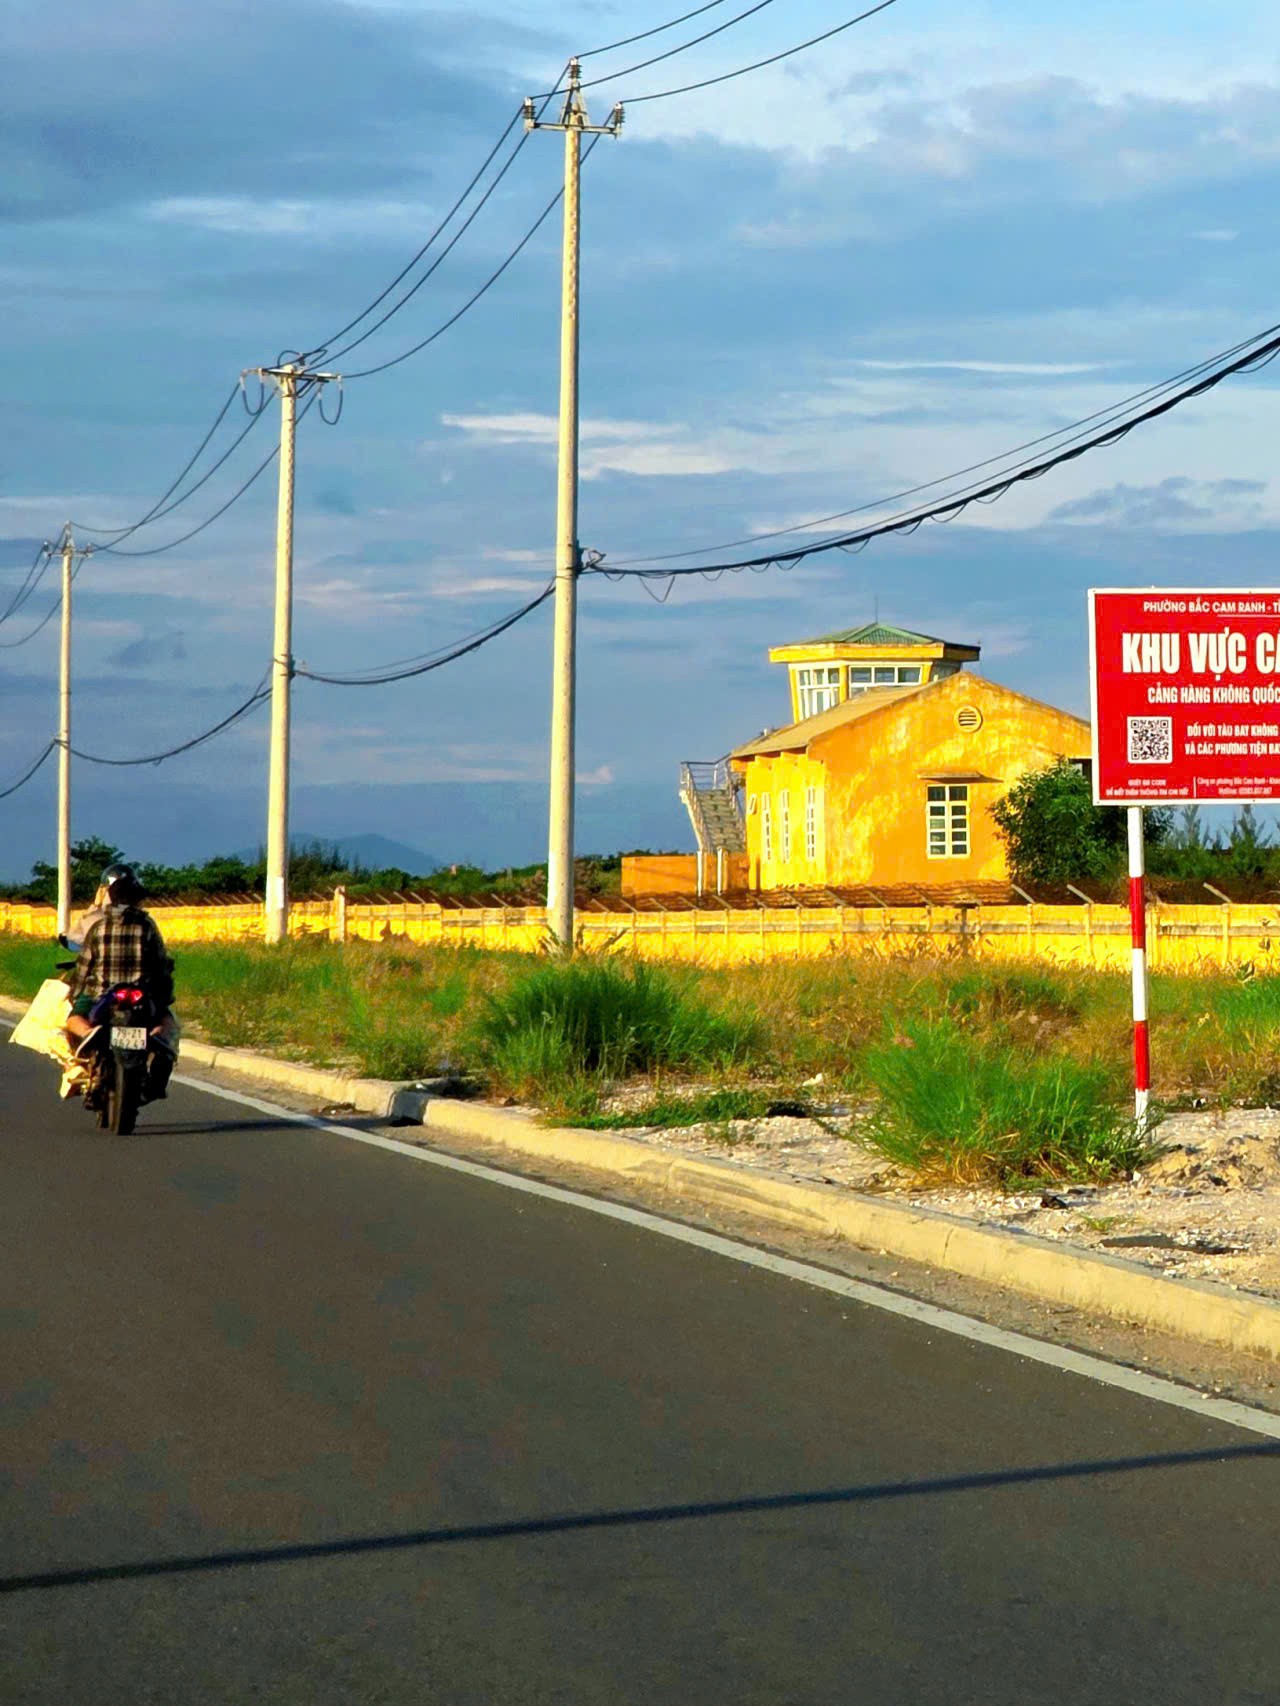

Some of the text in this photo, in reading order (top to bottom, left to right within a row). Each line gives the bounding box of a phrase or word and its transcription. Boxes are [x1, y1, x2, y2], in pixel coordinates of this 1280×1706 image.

[1143, 598, 1187, 613] PHƯỜNG
[1189, 597, 1211, 613] BẮC
[1212, 601, 1237, 613] CAM
[1237, 601, 1263, 613] RANH
[1122, 632, 1180, 673] KHU
[1188, 626, 1247, 681] VỰC
[1147, 682, 1178, 703] CẢNG
[1181, 683, 1211, 703] HÀNG
[1213, 683, 1250, 703] KHÔNG
[1234, 724, 1249, 737] BAY
[1184, 741, 1196, 755] VÀ
[1197, 741, 1214, 755] CÁC
